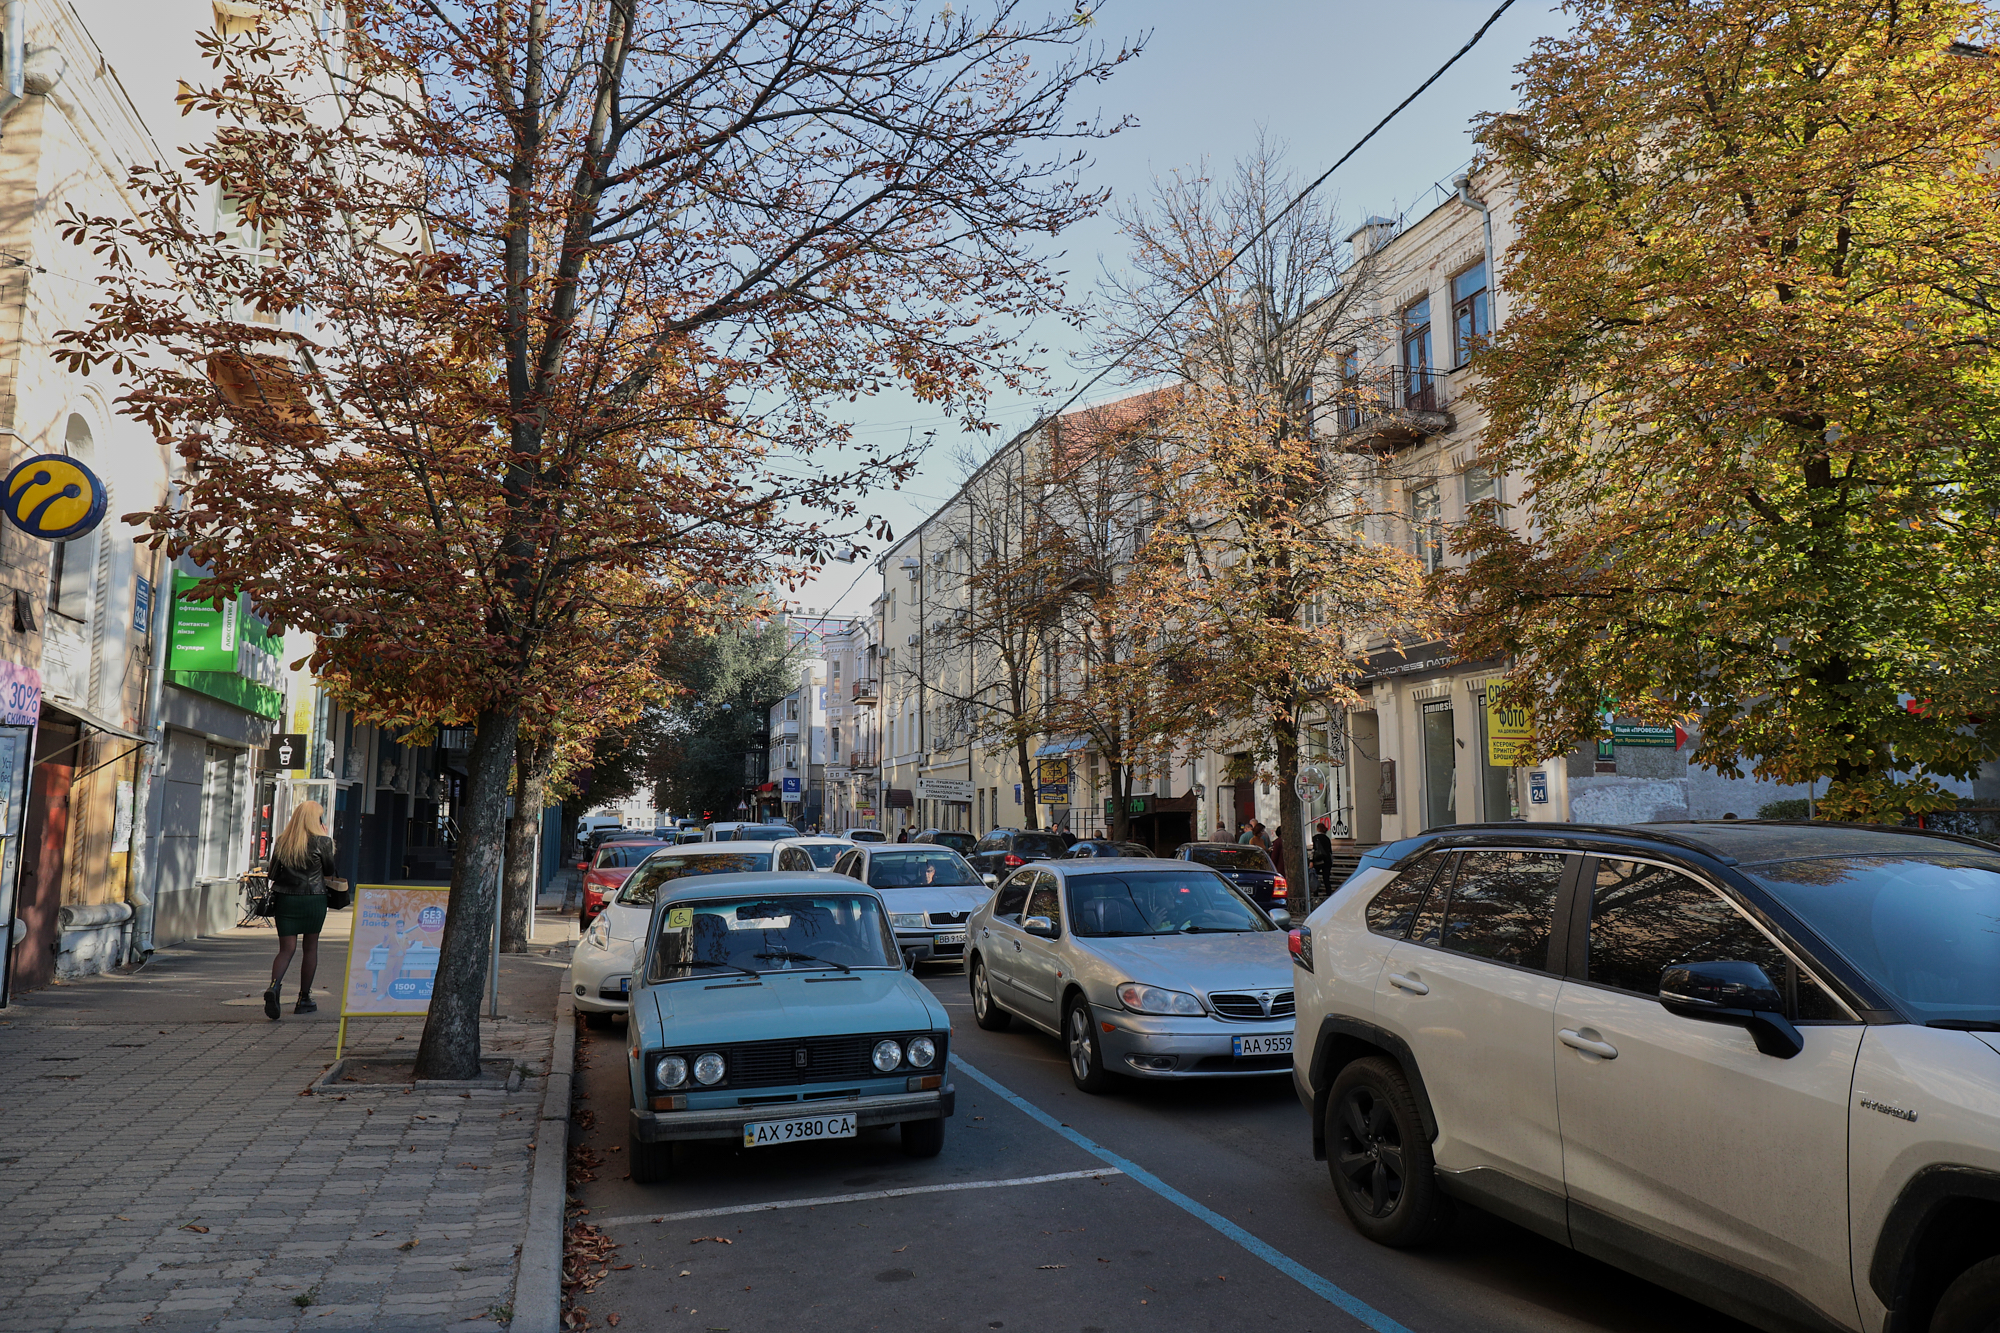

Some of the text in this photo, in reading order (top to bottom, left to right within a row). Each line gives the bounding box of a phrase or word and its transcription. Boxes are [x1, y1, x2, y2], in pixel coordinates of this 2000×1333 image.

[176, 644, 205, 652] Окуляри
[9, 681, 39, 713] 30%
[1499, 708, 1525, 727] ФОТО
[1533, 789, 1545, 801] 24
[362, 910, 400, 918] Вільний
[423, 910, 442, 919] БЕЗ
[361, 919, 390, 928] Лайф
[939, 935, 950, 944] BB
[1243, 1036, 1292, 1054] AA 9559
[757, 1118, 851, 1143] AX 9380 CA
